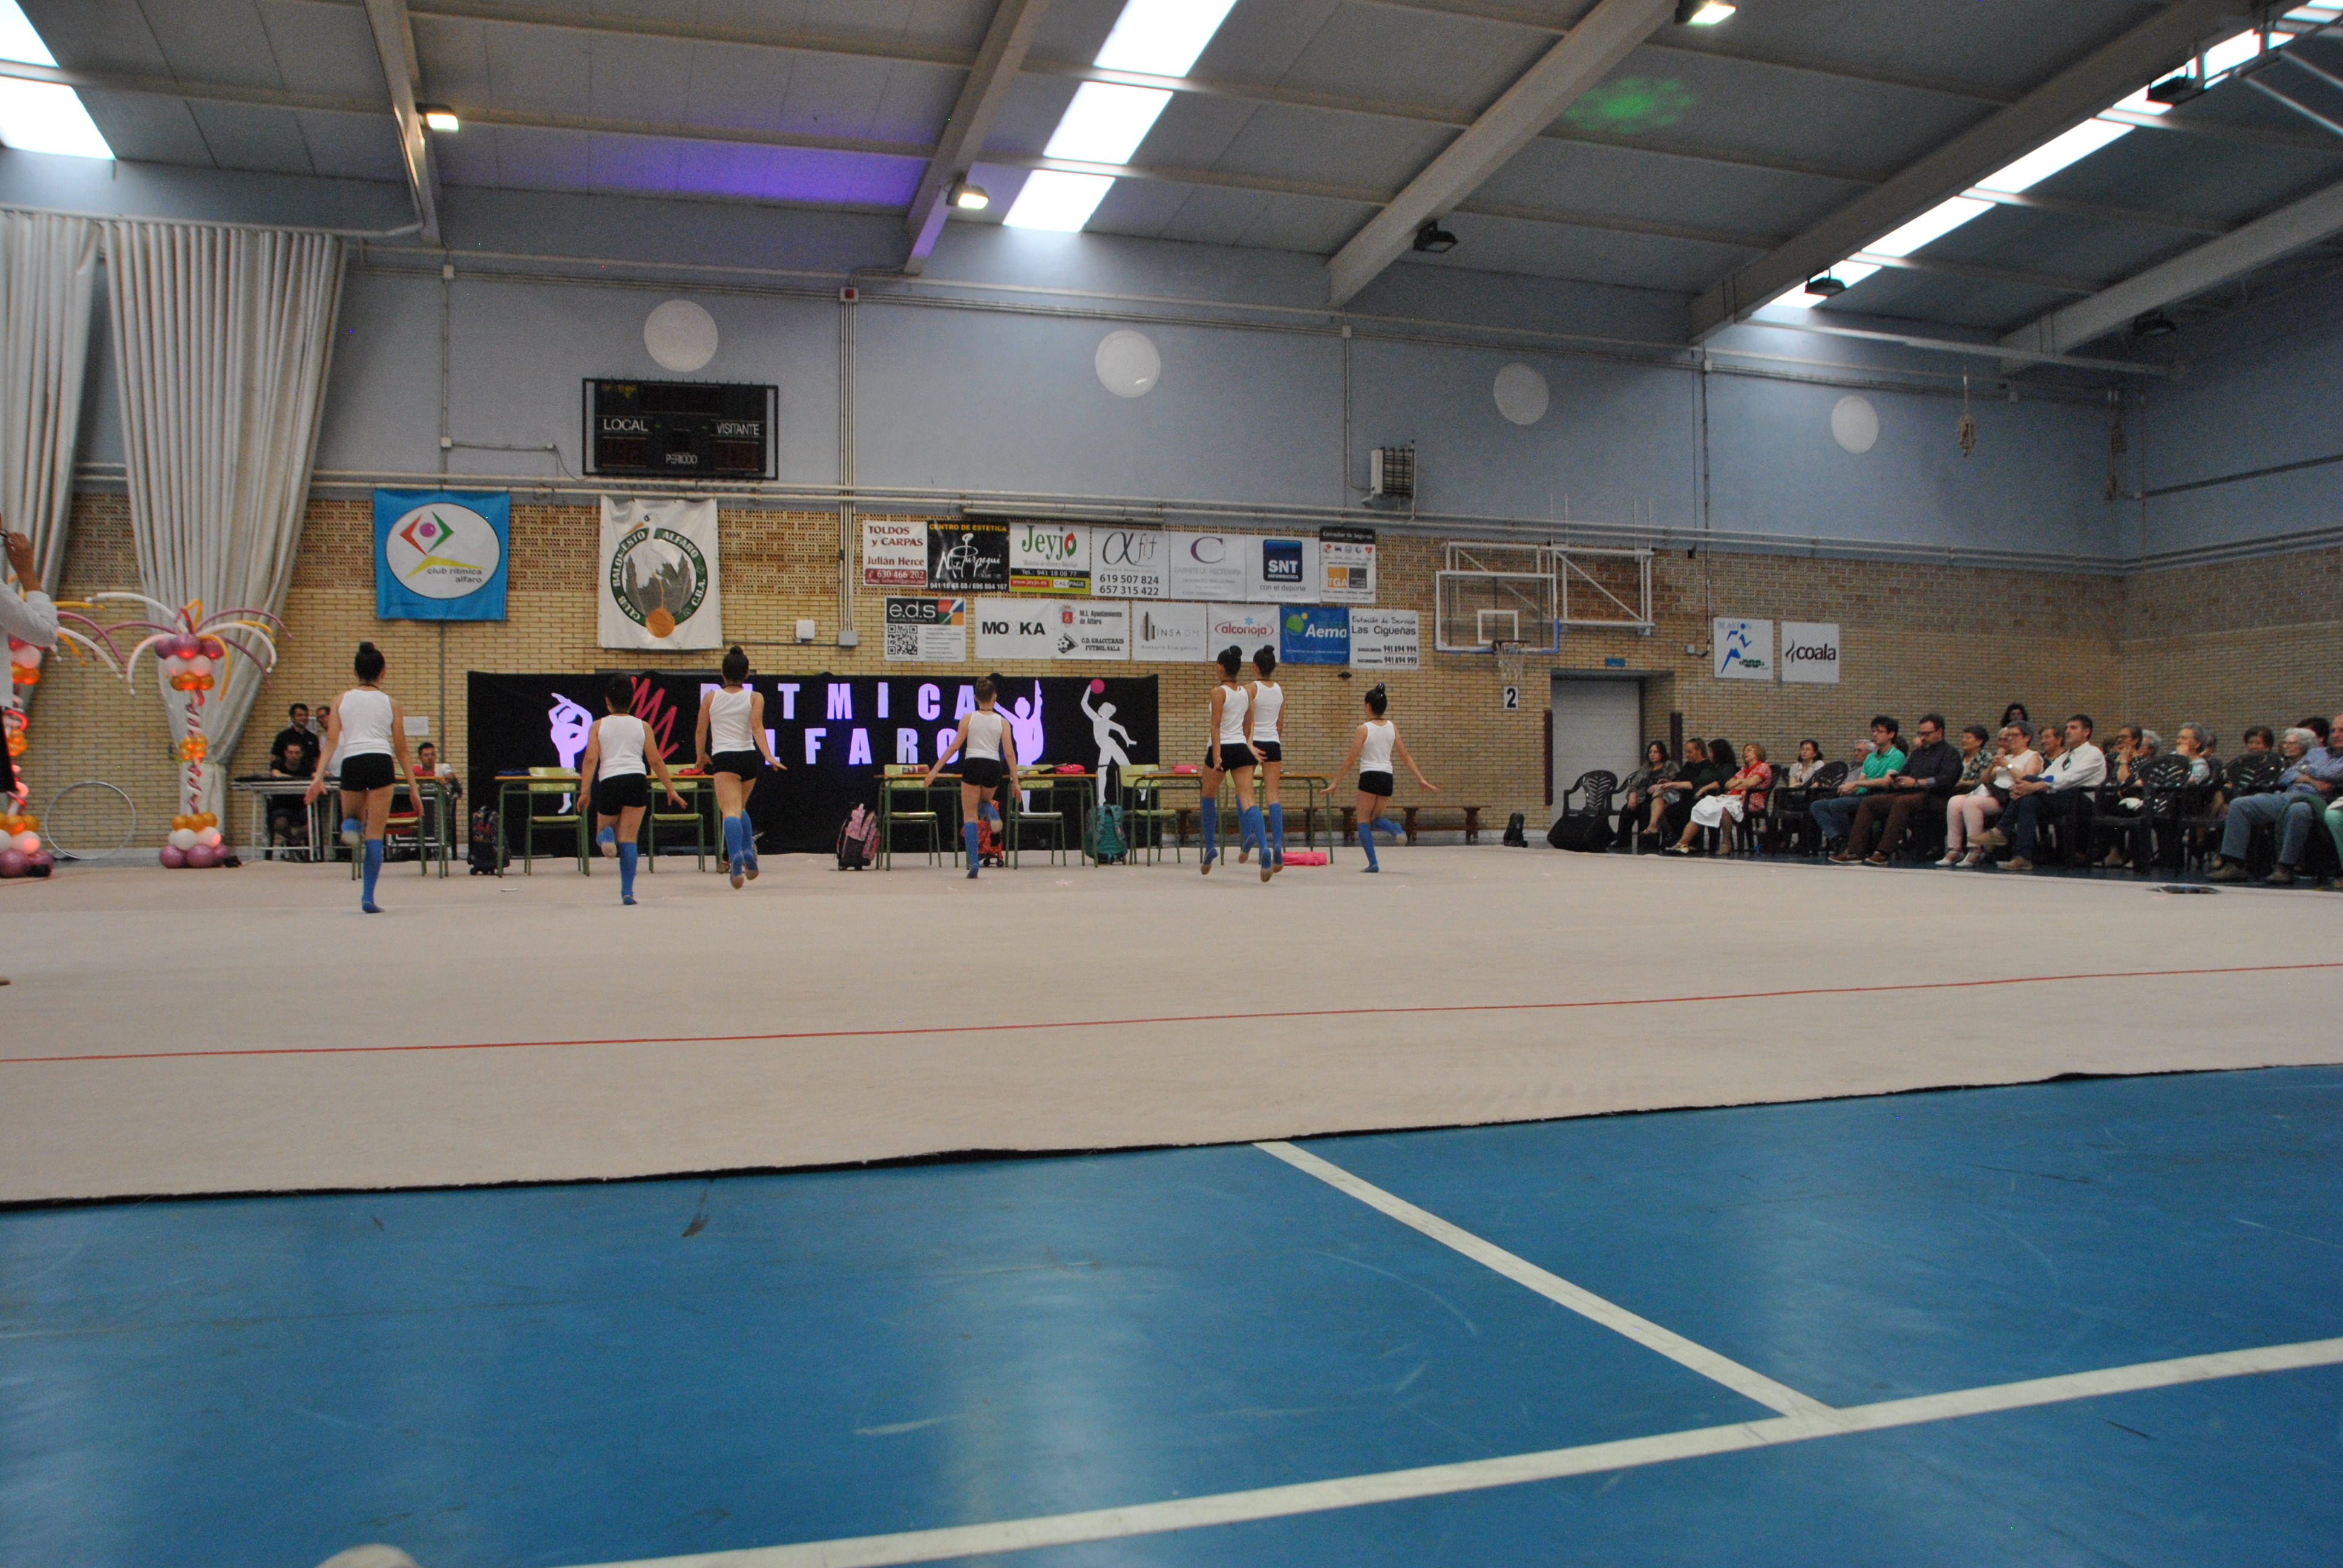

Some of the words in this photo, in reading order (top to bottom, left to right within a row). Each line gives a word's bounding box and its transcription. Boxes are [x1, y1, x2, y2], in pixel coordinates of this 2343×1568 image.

[603, 418, 649, 432] LOCAL
[716, 422, 760, 435] VISITANTE
[666, 454, 698, 465] PERIODO
[868, 526, 910, 535] TOLDOS
[662, 531, 699, 558] ALFARO
[881, 537, 923, 546] CARPAS
[612, 530, 646, 587] BALOESTO
[867, 556, 895, 565] Julián
[898, 557, 925, 566] Herce
[1268, 560, 1298, 573] SNT
[909, 570, 925, 579] 202
[1099, 573, 1118, 583] 619
[1121, 575, 1138, 584] 507
[1141, 575, 1159, 584] 824
[1099, 585, 1118, 593] 657
[1121, 586, 1138, 595] 315
[1141, 587, 1159, 596] 422
[618, 595, 640, 621] CLUB
[1305, 623, 1347, 638] Aema
[1351, 625, 1369, 634] Las
[1796, 642, 1837, 661] coala
[700, 682, 977, 720] TMICA
[1507, 687, 1516, 708] 2
[765, 728, 960, 765] LFARO
